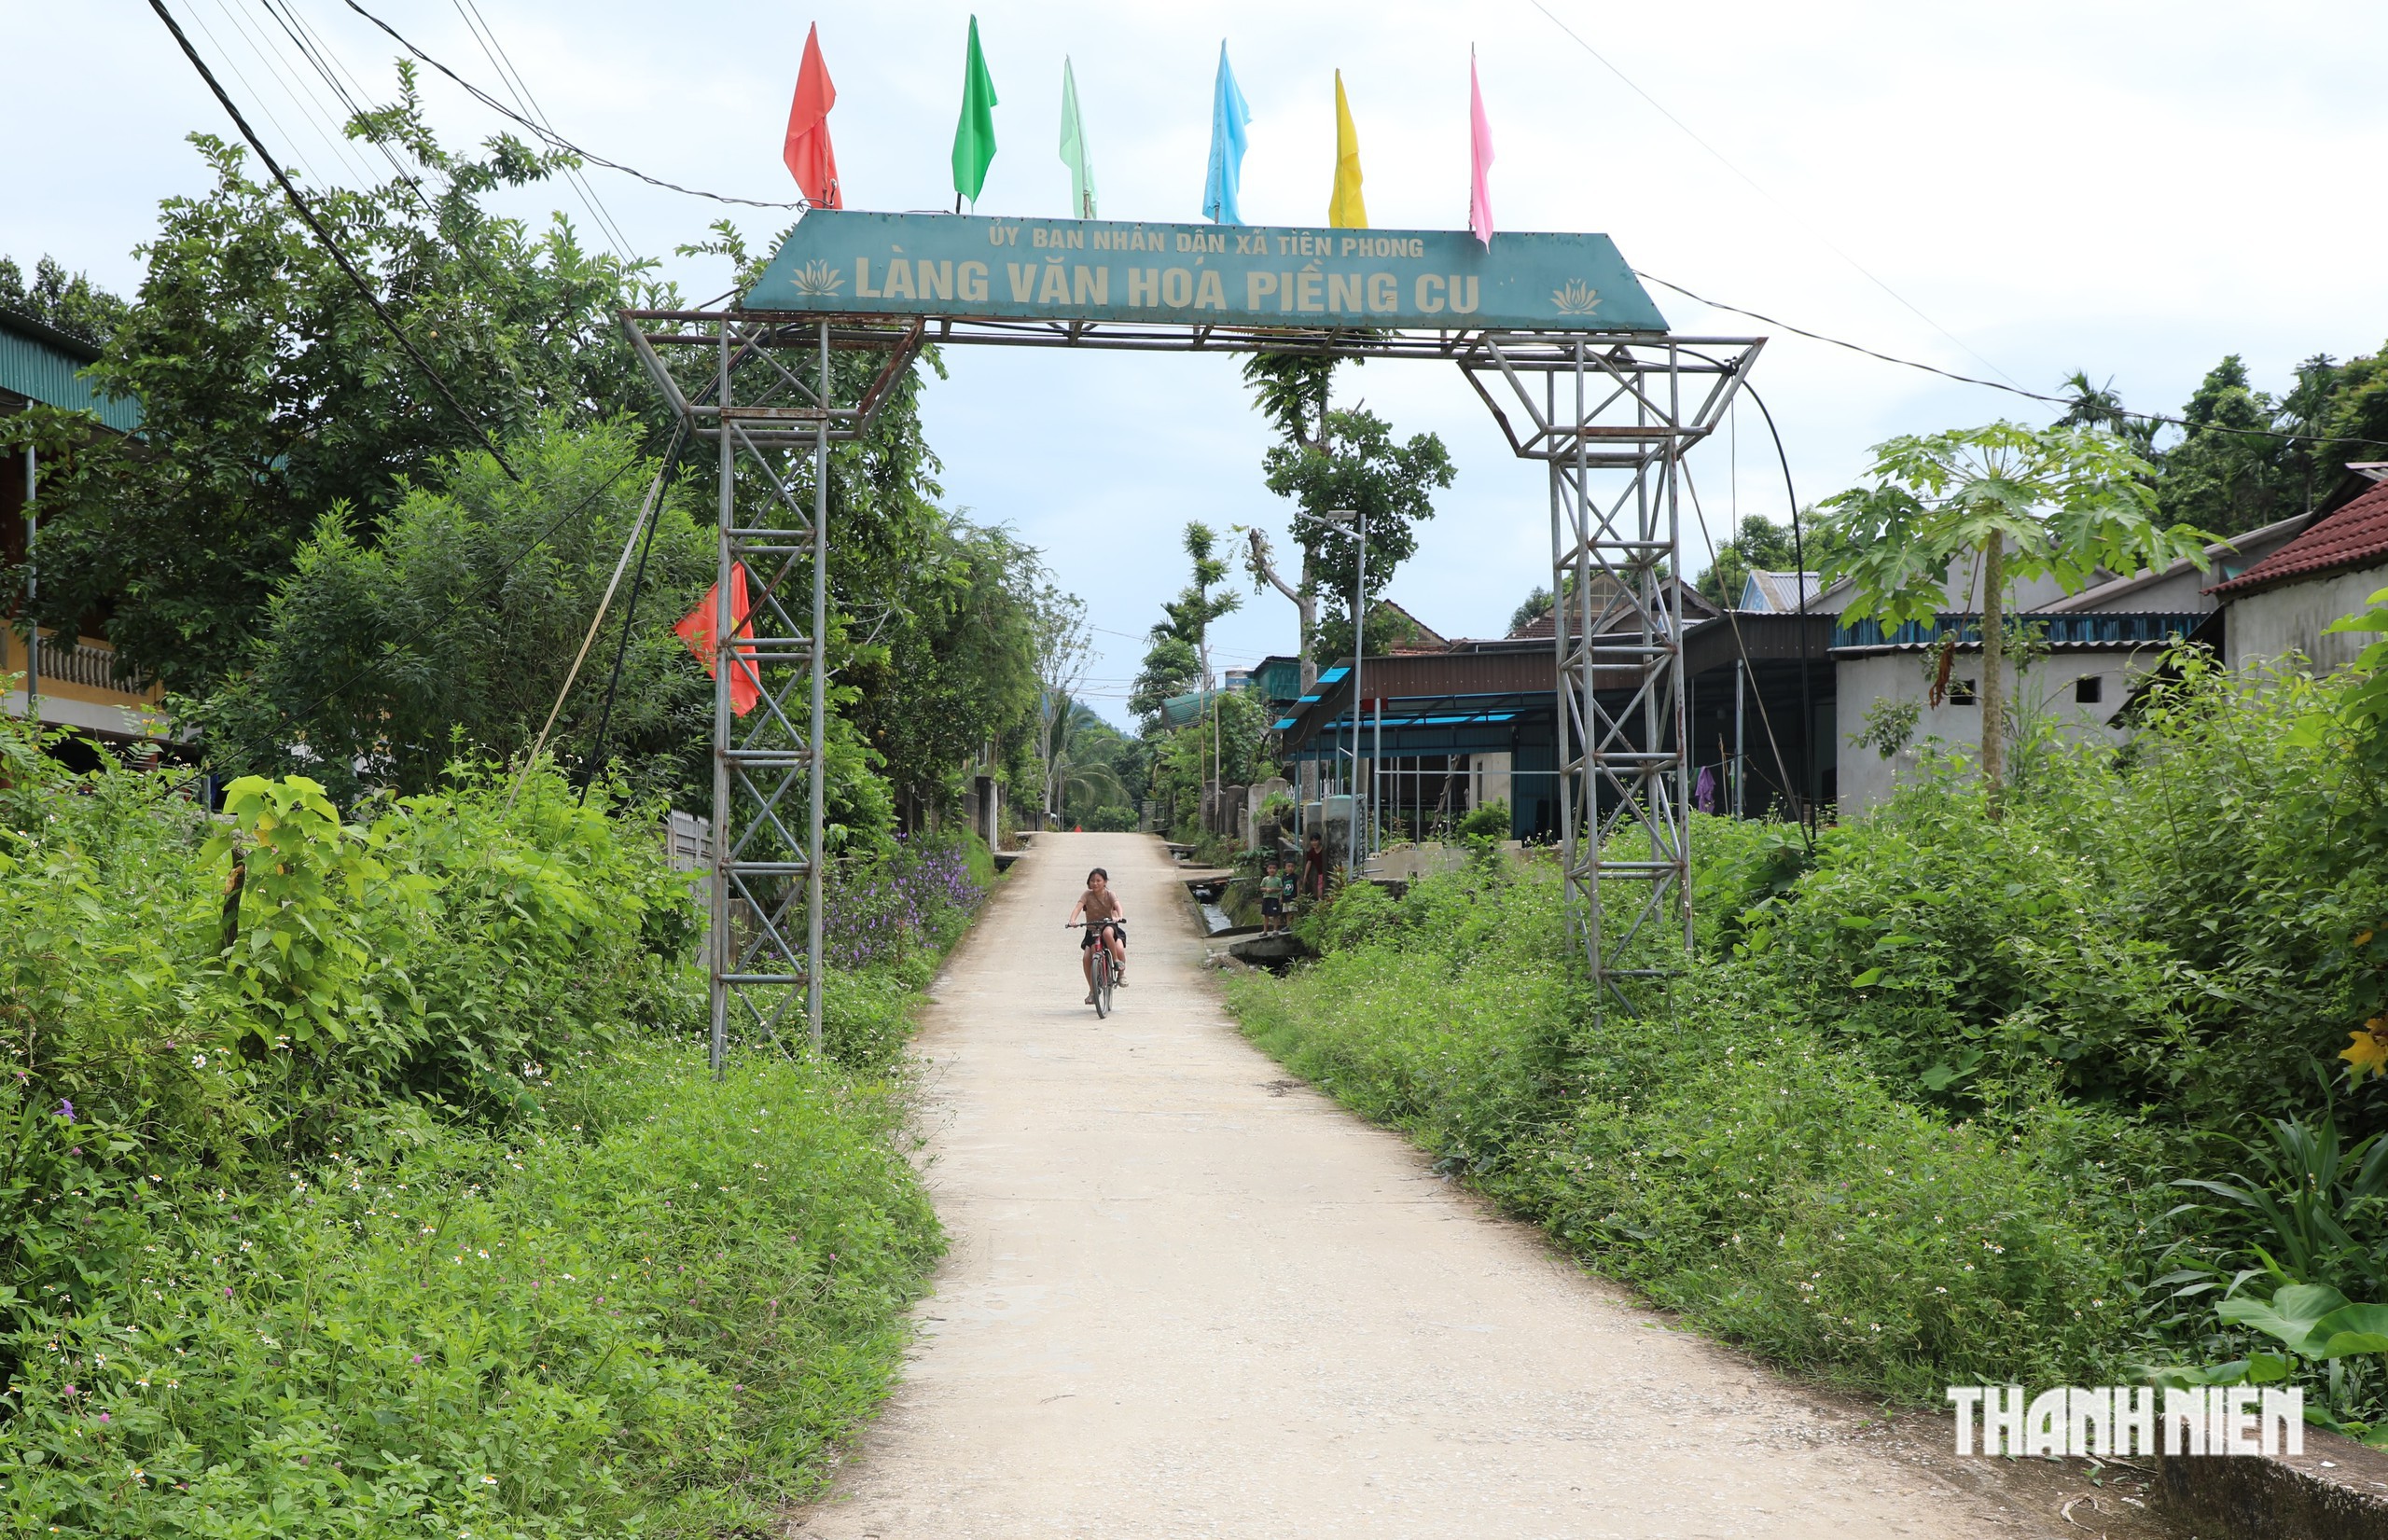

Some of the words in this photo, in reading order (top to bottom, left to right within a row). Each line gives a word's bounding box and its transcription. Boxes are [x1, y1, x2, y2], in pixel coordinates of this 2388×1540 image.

[1033, 228, 1084, 249] BAN
[1093, 226, 1165, 252] NHÂN
[1176, 229, 1225, 254] DÂN
[1236, 229, 1269, 256] XÃ
[1341, 237, 1423, 257] PHONG
[855, 244, 989, 301] LÀNG
[1007, 256, 1108, 306] VĂN
[1128, 256, 1227, 310] HOÁ
[1247, 258, 1397, 312] PIỀNG
[1415, 273, 1479, 313] CU
